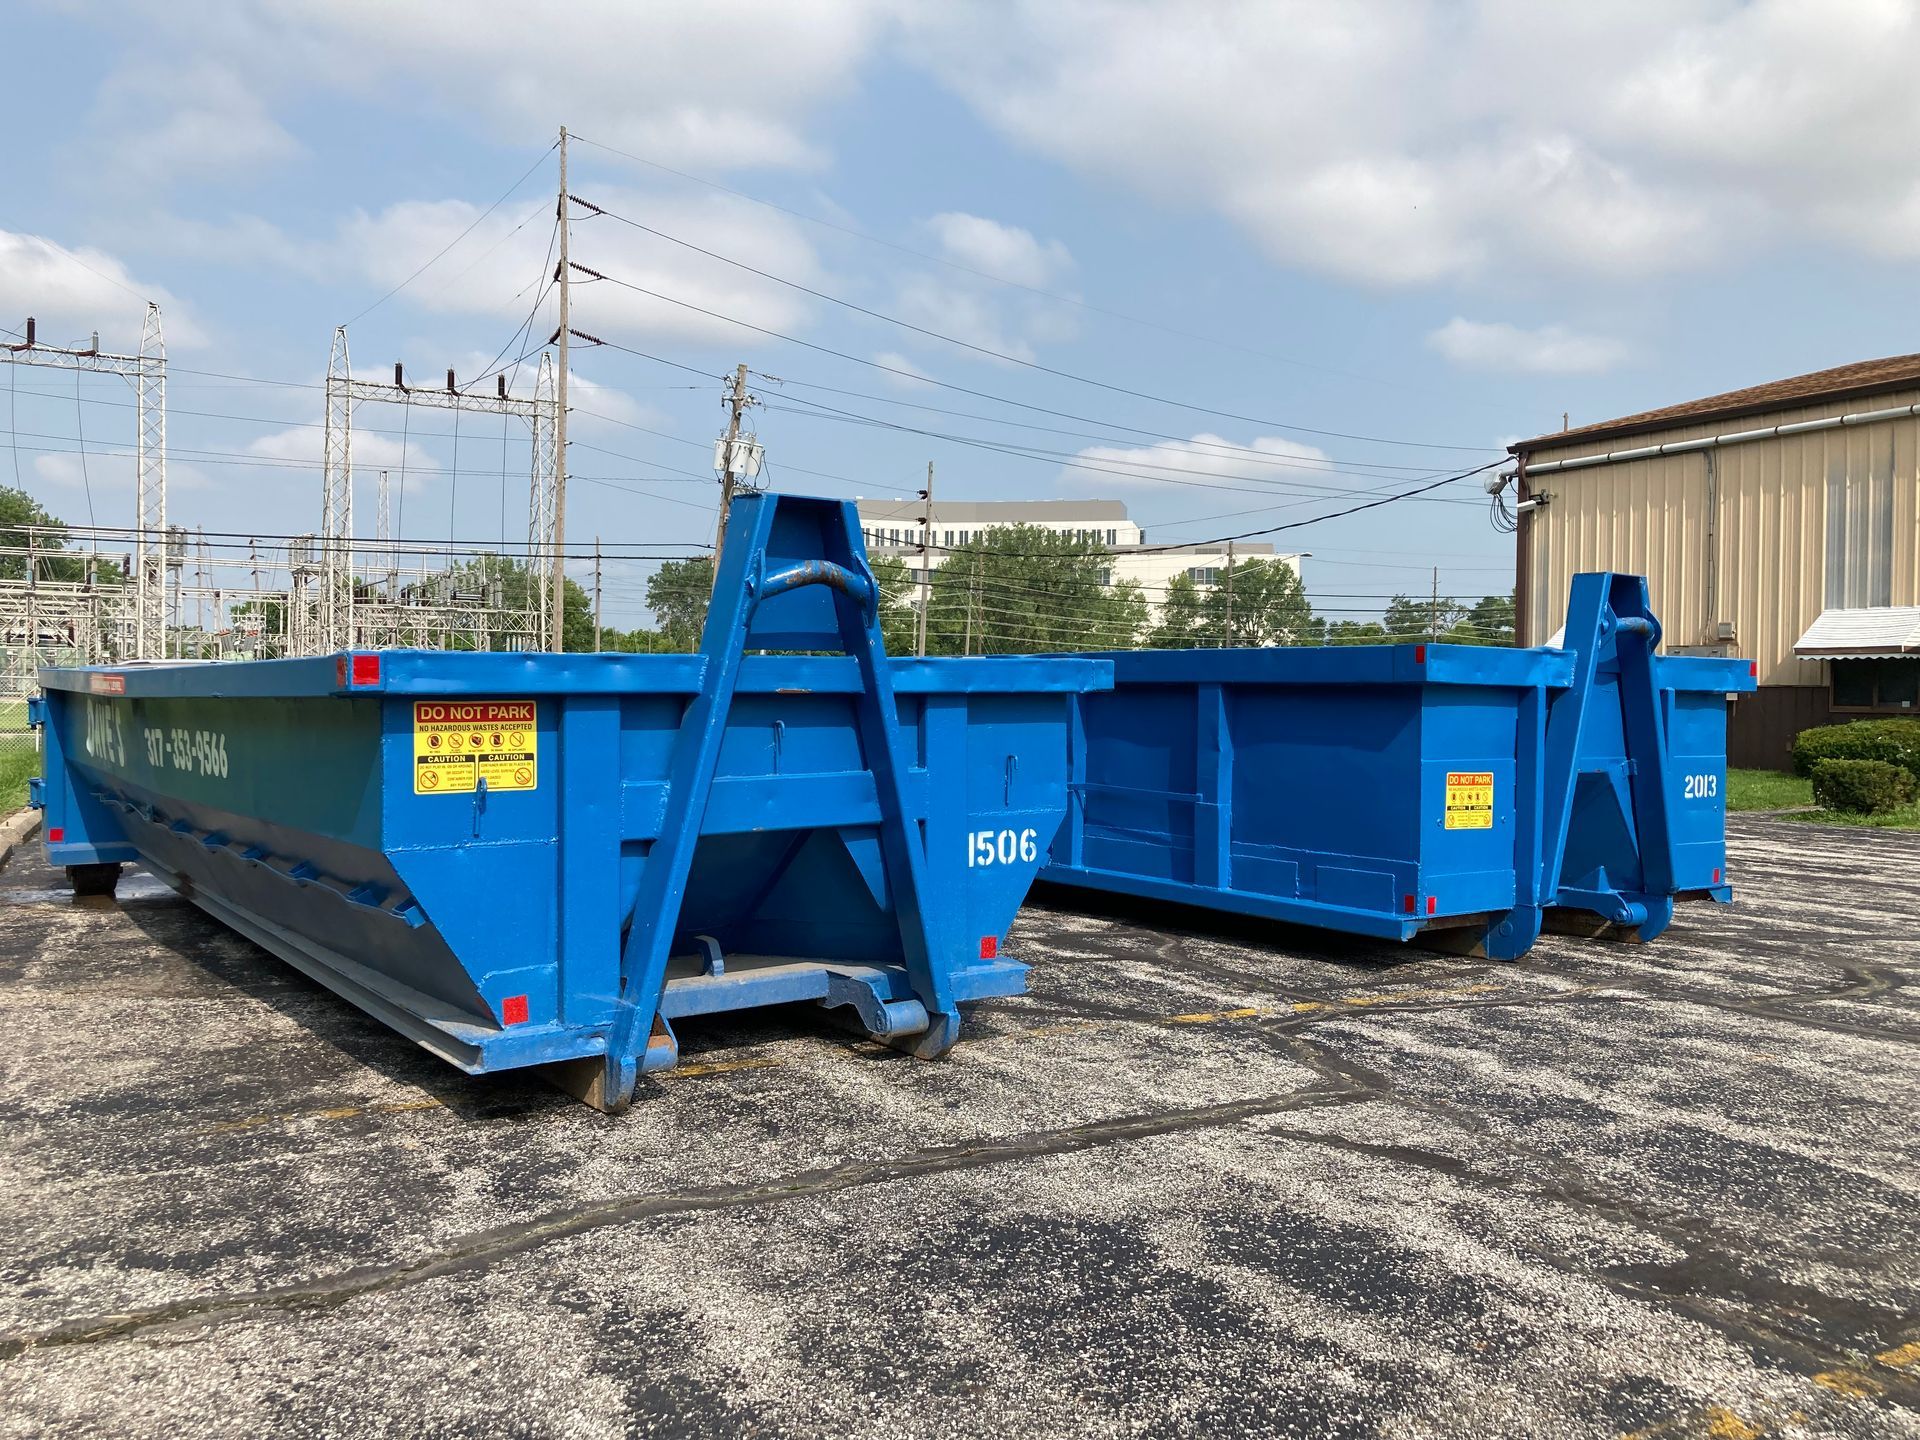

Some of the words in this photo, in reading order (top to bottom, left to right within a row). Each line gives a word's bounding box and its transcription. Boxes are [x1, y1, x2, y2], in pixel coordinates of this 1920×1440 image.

[420, 706, 445, 720] DO
[450, 706, 484, 720] NOT
[488, 706, 530, 719] PARK
[144, 727, 228, 779] 317-353-9566
[1450, 776, 1459, 784] DO
[1460, 776, 1474, 784] NOT
[1474, 776, 1492, 784] PARK
[1684, 774, 1717, 798] 2013
[968, 828, 1037, 868] 1506
